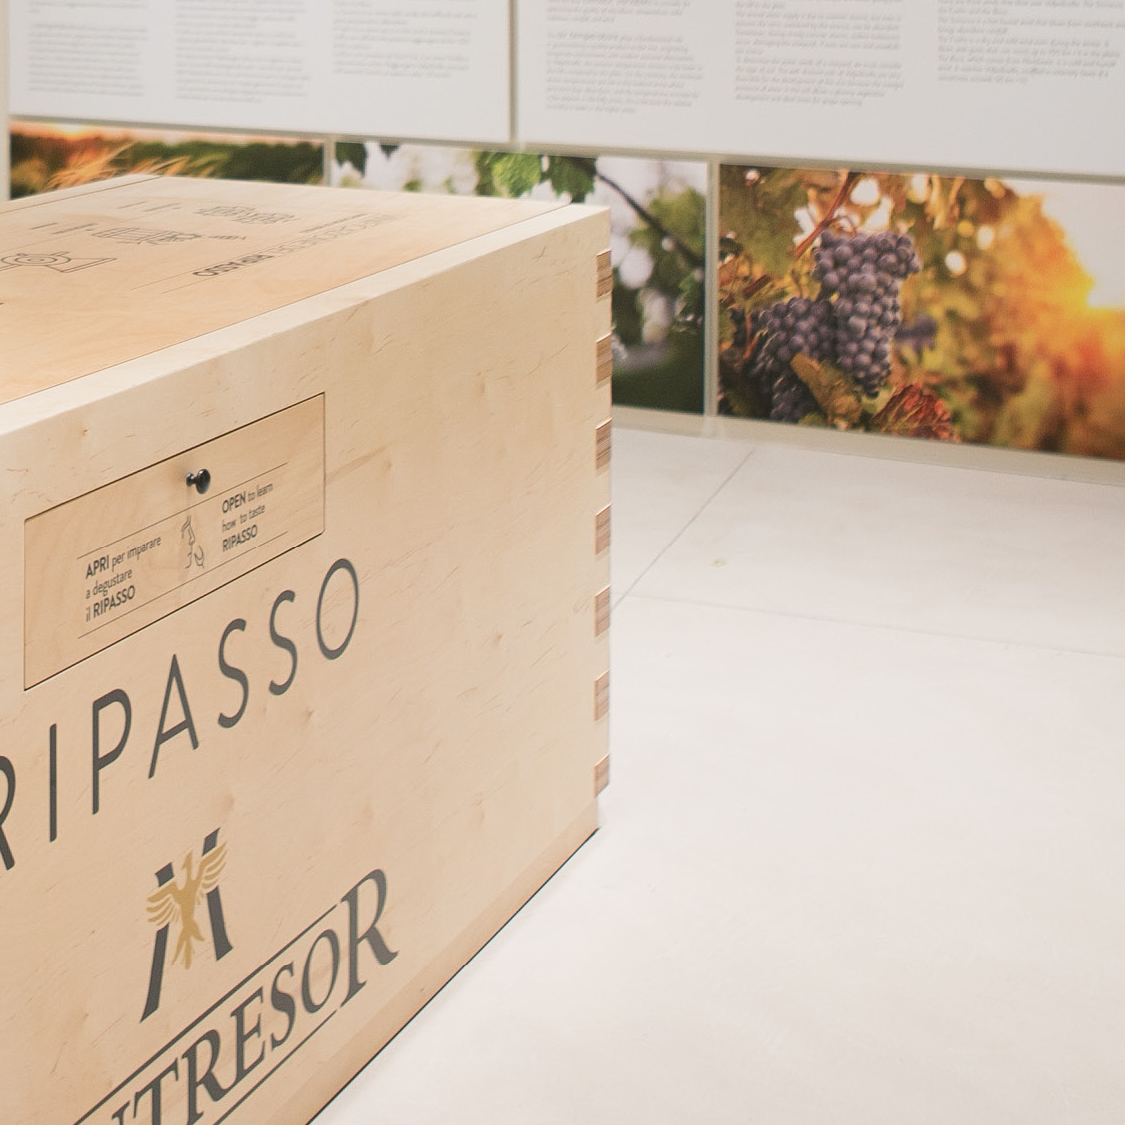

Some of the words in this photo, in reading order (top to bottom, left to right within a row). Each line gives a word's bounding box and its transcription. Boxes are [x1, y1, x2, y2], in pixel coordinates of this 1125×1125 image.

[222, 491, 246, 513] OPEN
[248, 492, 255, 502] to
[257, 483, 273, 497] learn
[222, 519, 236, 532] how
[240, 514, 247, 524] to
[249, 505, 265, 519] taste
[222, 524, 258, 552] RIPASSO
[86, 555, 109, 579] APRI
[112, 553, 125, 572] per
[127, 537, 161, 560] imparare
[86, 589, 91, 599] a
[93, 569, 132, 596] degustare
[86, 606, 91, 622] il
[93, 585, 135, 618] RIPASSO
[112, 869, 398, 1125] TRESOR
